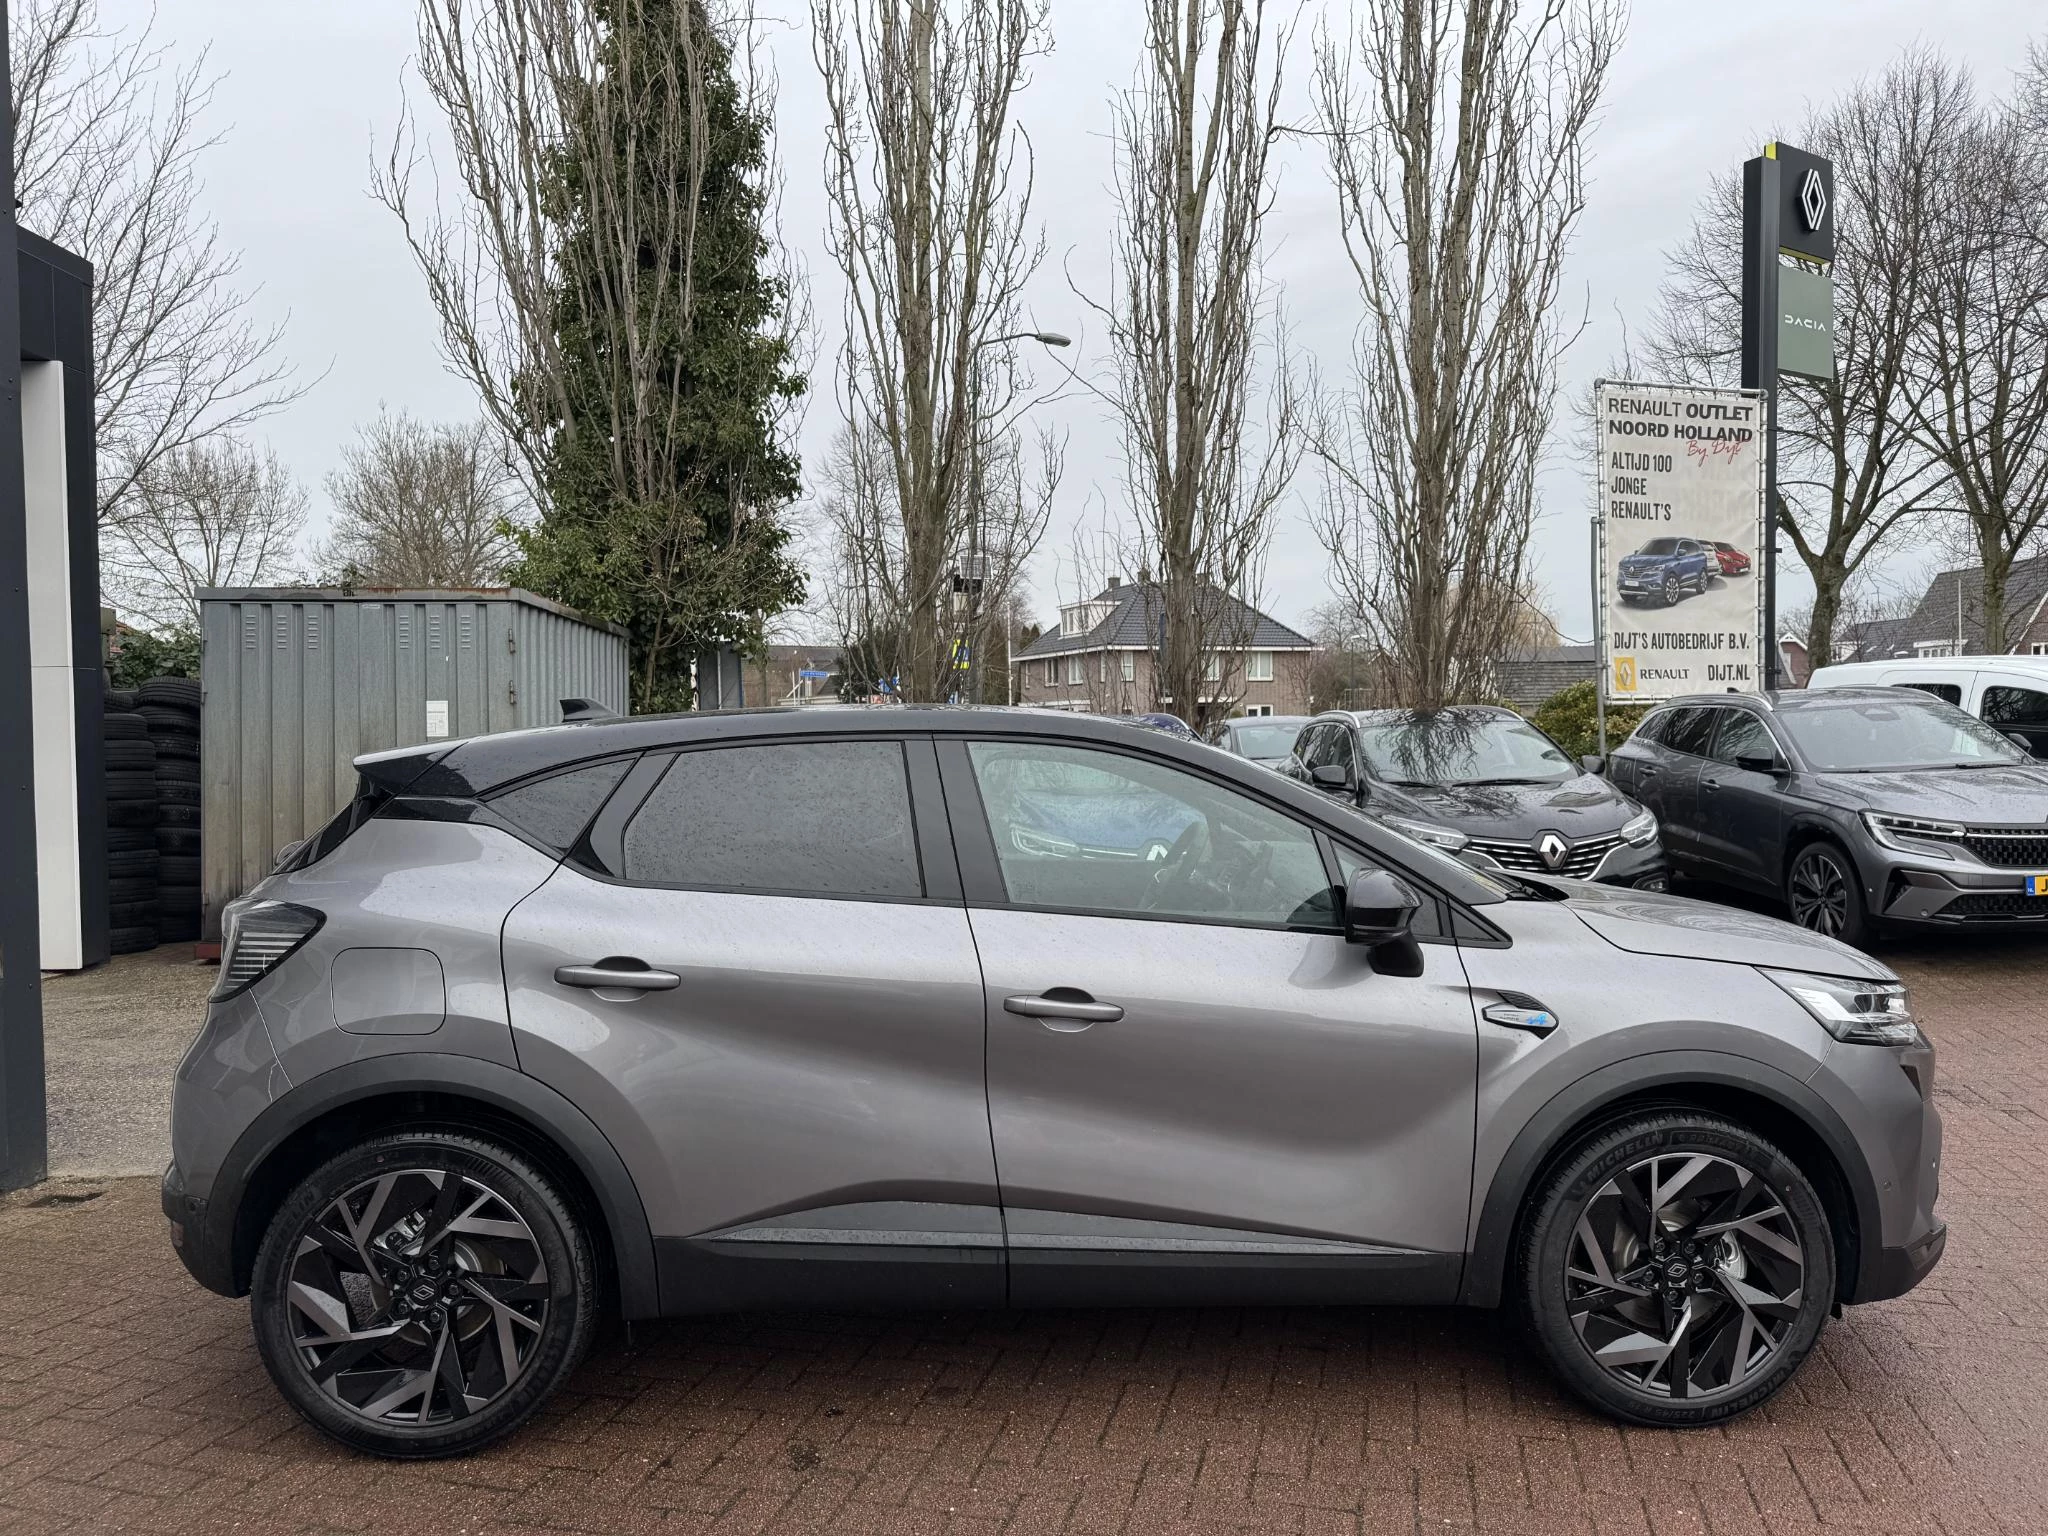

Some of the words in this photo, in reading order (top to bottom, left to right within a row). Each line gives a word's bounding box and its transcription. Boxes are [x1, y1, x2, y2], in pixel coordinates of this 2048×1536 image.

[1785, 314, 1826, 332] DACIA
[1608, 398, 1682, 417] RENAULT
[1686, 403, 1753, 421] OUTLET
[1609, 420, 1669, 438] NOORD
[1674, 424, 1753, 442] HOLLAND
[1611, 452, 1650, 471] ALTIJD
[1653, 455, 1672, 473] 100
[1686, 440, 1708, 467] By
[1611, 476, 1647, 495] JONGE
[1611, 501, 1672, 521] RENAULT'S
[1614, 632, 1649, 650] DIJT'S
[1651, 632, 1724, 650] AUTOBEDRIJF
[1728, 633, 1750, 650] B.V.
[1640, 669, 1690, 680] RENAULT
[1708, 664, 1751, 681] DIJT.NL
[1587, 1133, 1663, 1180] MICHELIN
[1711, 1370, 1787, 1417] MICHELIN
